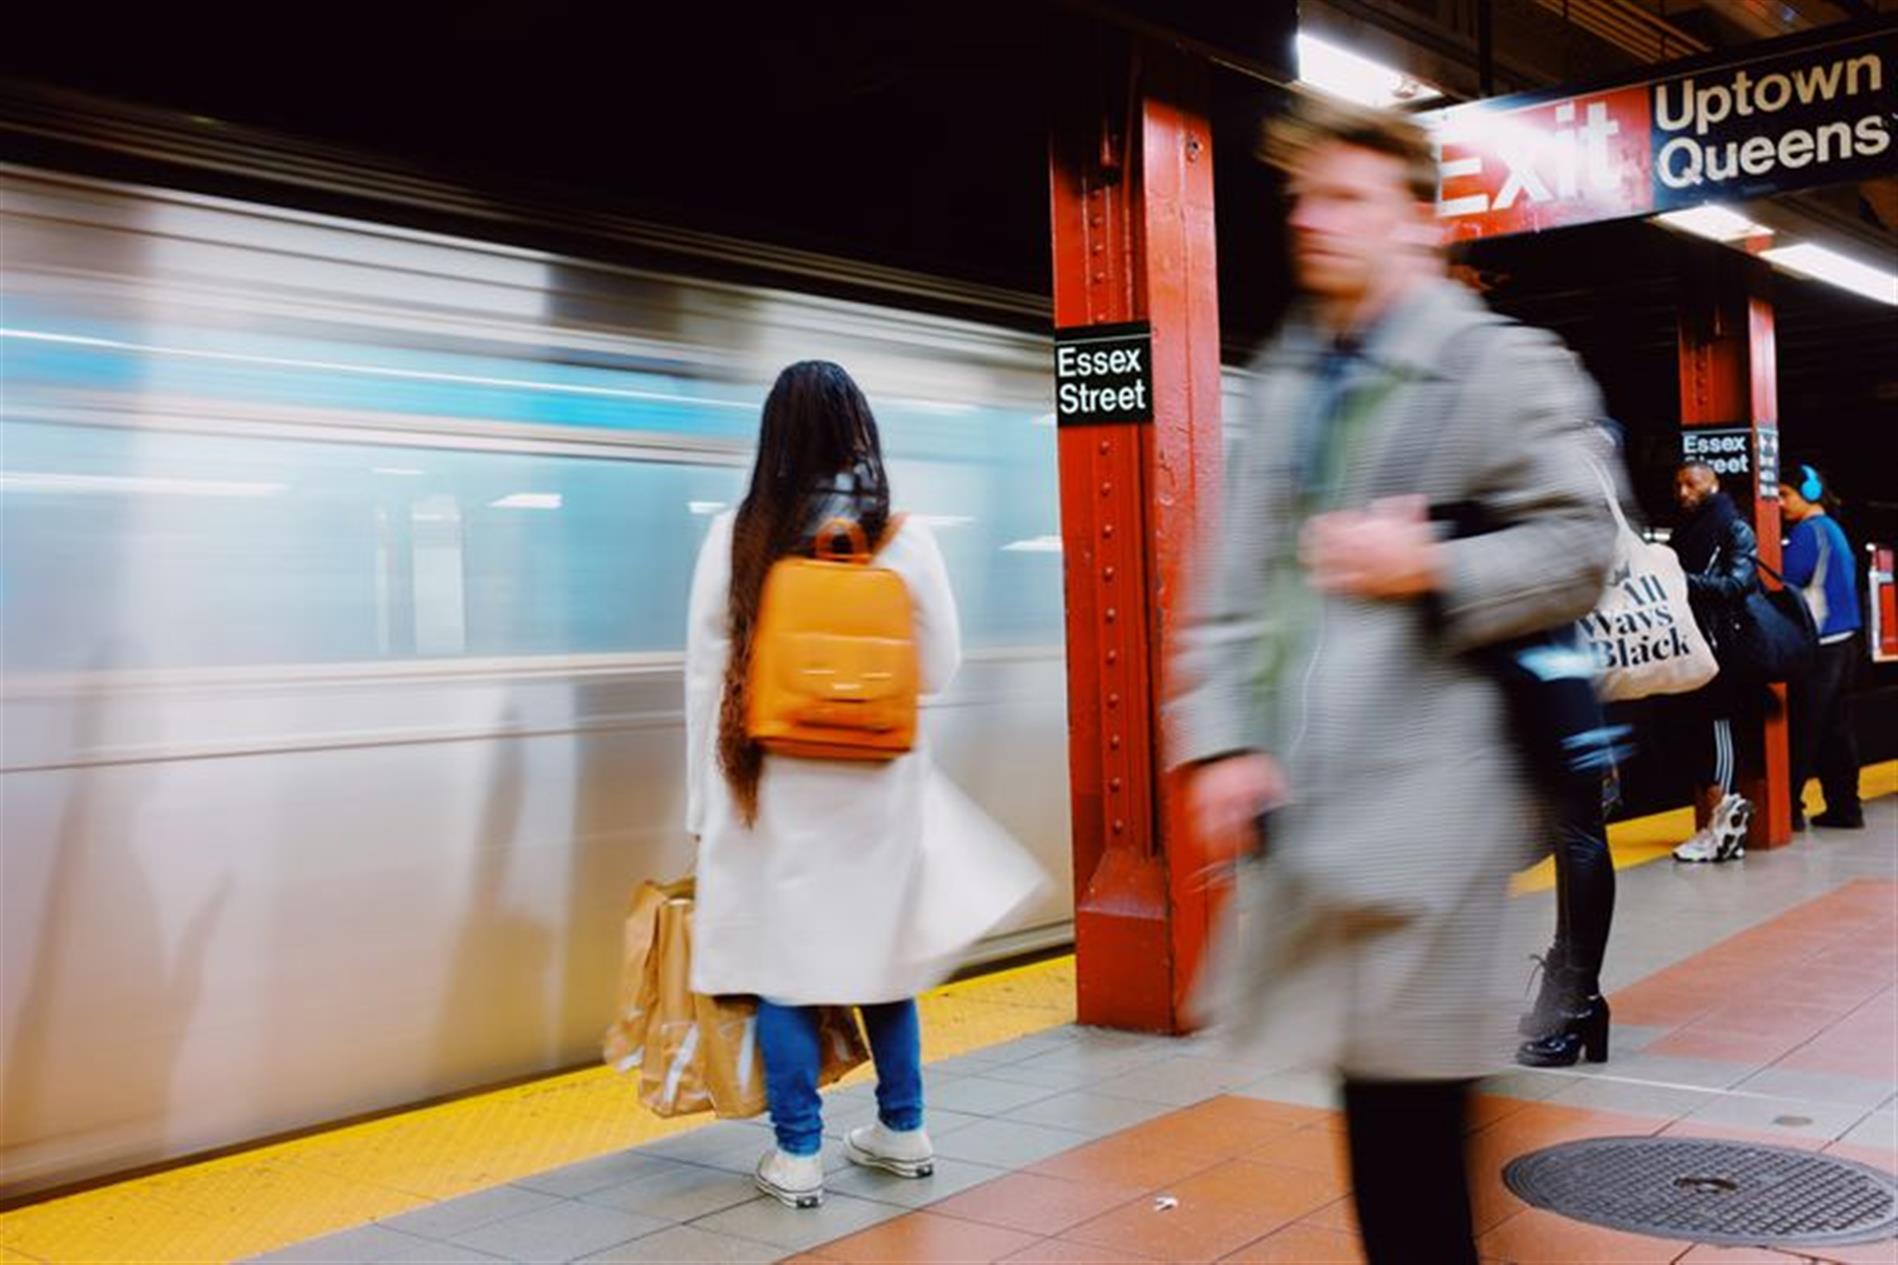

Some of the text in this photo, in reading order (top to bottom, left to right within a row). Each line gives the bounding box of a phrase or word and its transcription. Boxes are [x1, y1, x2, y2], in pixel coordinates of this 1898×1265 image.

[1656, 54, 1882, 135] Uptown
[1437, 100, 1621, 218] Exit
[1658, 115, 1891, 188] Queens
[1057, 347, 1141, 377] Essex
[1059, 379, 1146, 413] Street
[1683, 435, 1746, 454] Essex
[1618, 574, 1668, 606] All
[1577, 605, 1674, 638] Ways
[1590, 627, 1690, 668] Black
